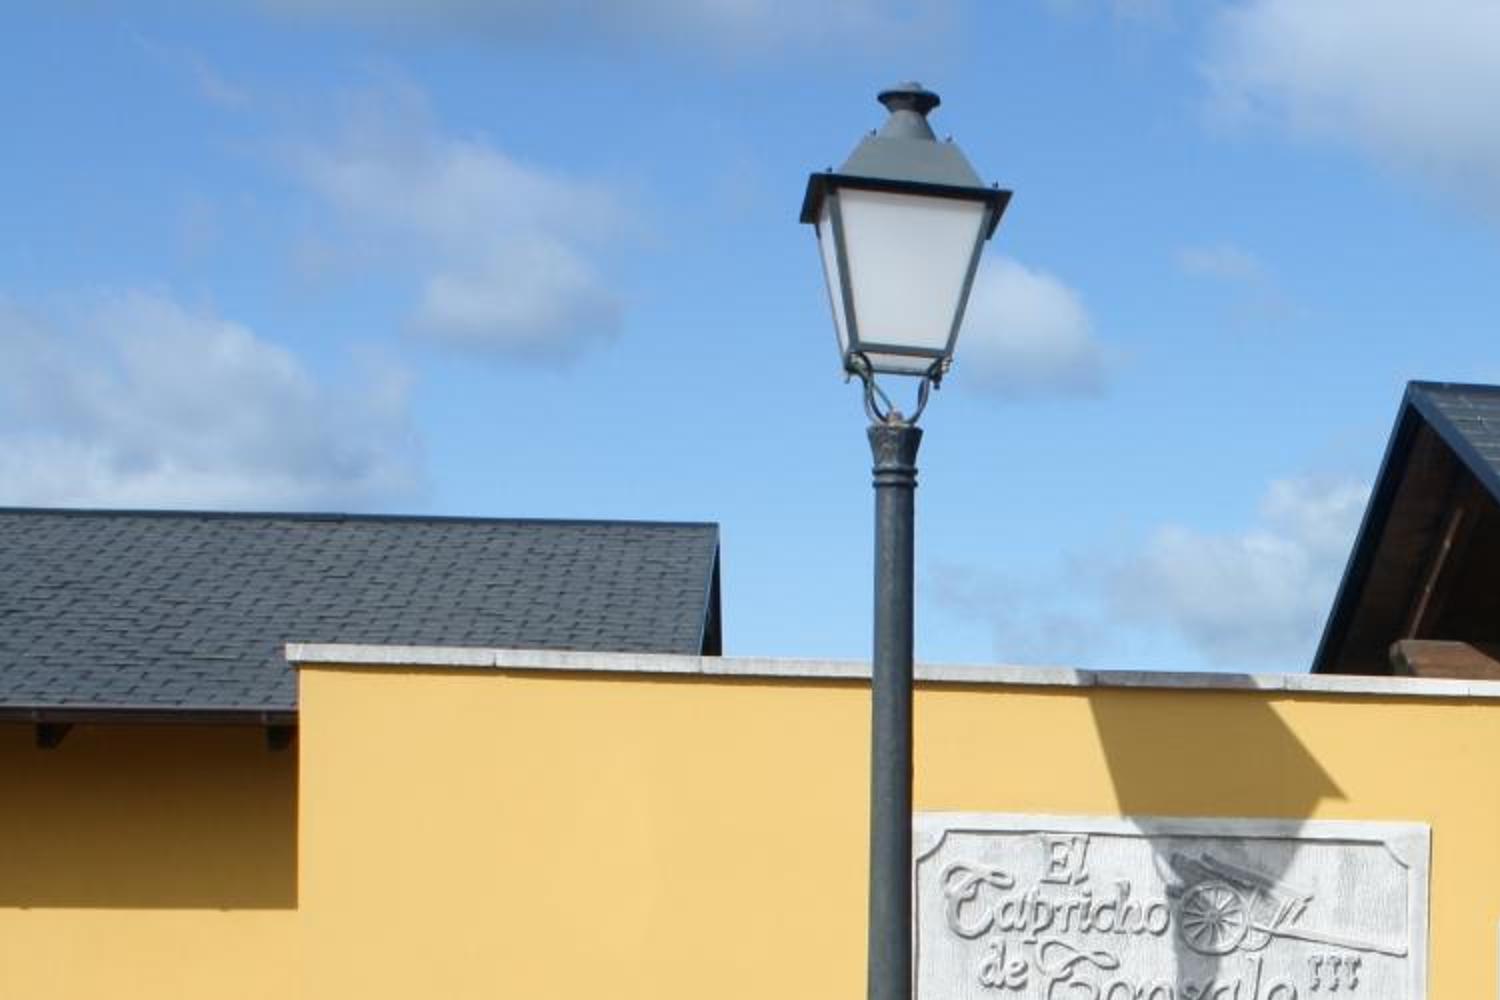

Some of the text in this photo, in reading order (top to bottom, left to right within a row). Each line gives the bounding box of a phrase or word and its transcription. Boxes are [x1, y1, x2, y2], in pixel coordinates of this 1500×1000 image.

[1041, 834, 1091, 885] El
[944, 865, 1171, 944] Capricho
[977, 942, 1029, 991] de
